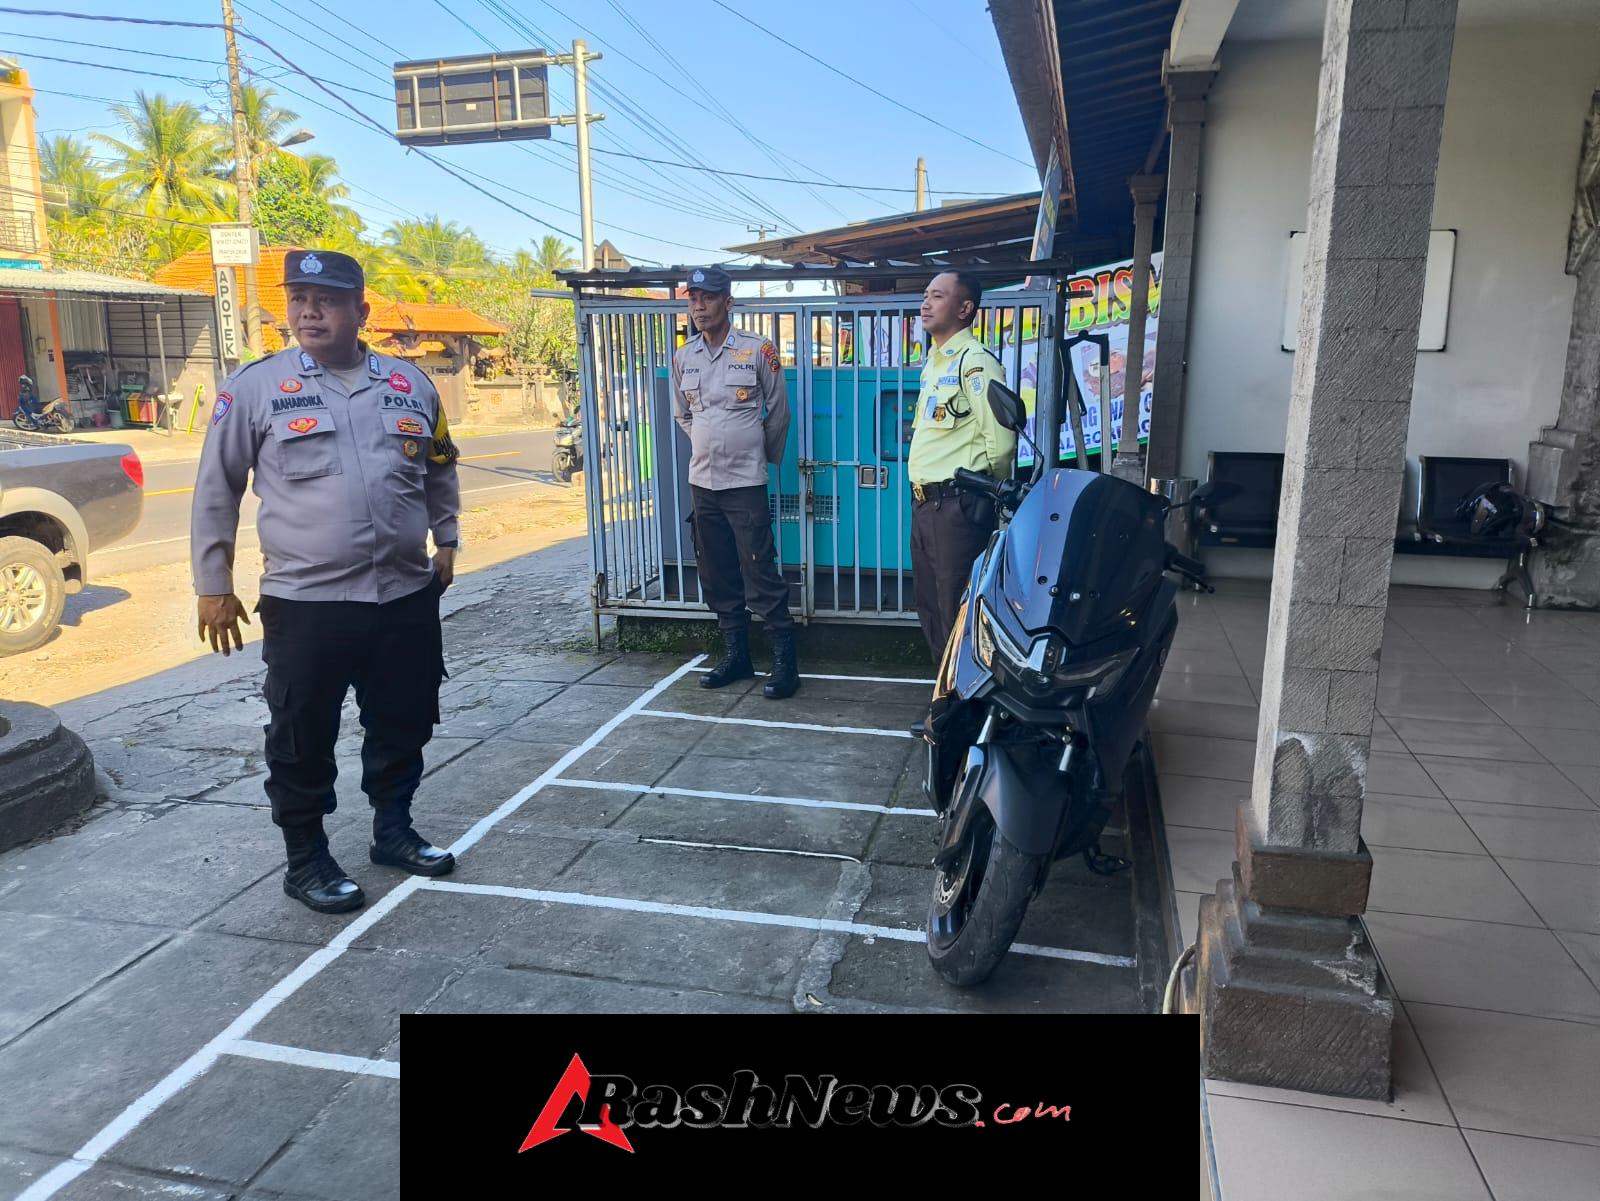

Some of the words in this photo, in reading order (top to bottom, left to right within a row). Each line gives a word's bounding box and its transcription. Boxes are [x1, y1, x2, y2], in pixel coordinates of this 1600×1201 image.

[219, 270, 234, 356] APOTEK
[271, 394, 324, 412] MAHARDIKA
[383, 395, 424, 411] POLRI
